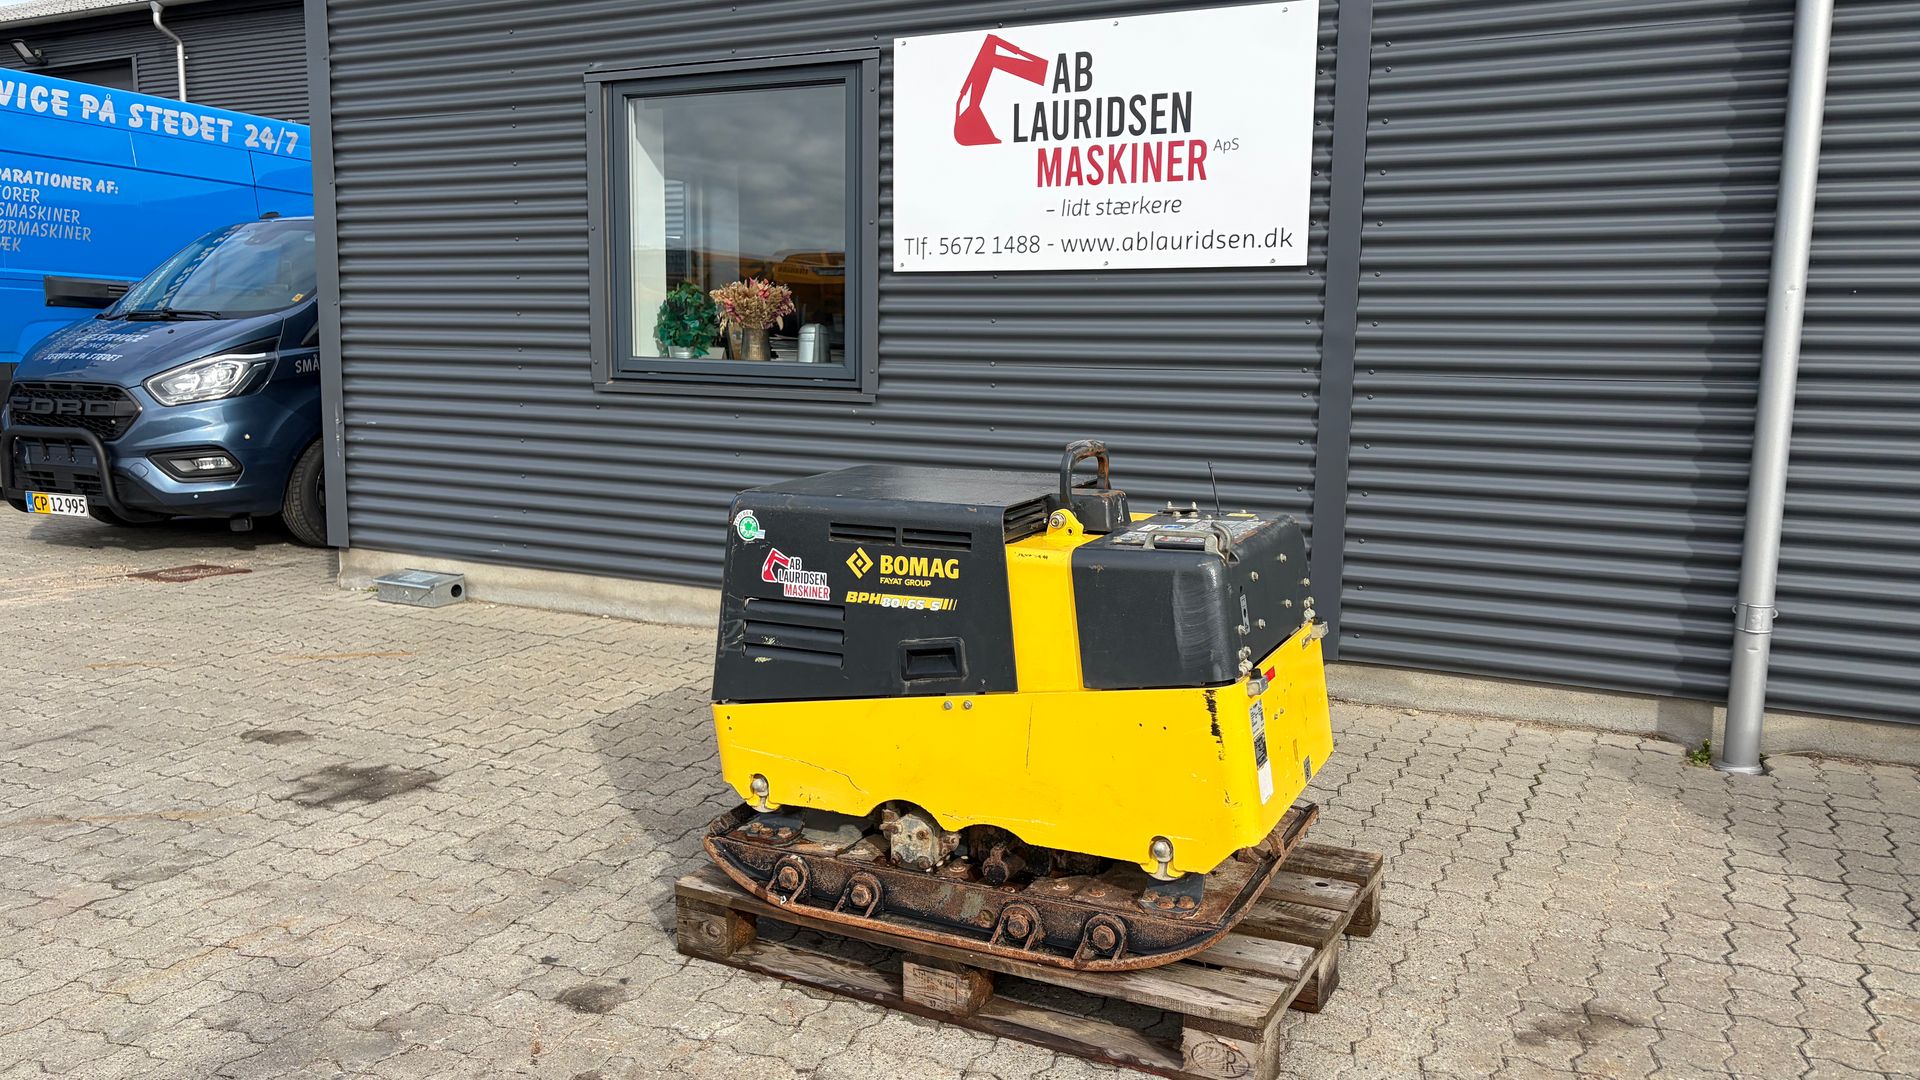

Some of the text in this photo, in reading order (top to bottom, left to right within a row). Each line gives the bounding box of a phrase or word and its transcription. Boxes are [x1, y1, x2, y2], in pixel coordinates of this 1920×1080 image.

[1052, 51, 1093, 94] AB
[80, 93, 116, 124] PÅ
[128, 103, 233, 143] STEDET
[244, 124, 299, 154] 24/7
[1013, 91, 1193, 143] LAURIDSEN
[1037, 137, 1240, 188] MASKINER ApS
[95, 179, 119, 194] AF:
[1061, 198, 1091, 217] lidt
[1096, 196, 1182, 216] stærkere
[904, 236, 933, 260] Tlf.
[939, 236, 986, 255] 5672
[992, 235, 1041, 254] 1488
[1061, 227, 1294, 253] www.ablauridsen.dk
[34, 496, 48, 511] CP
[789, 558, 801, 570] AB
[880, 555, 960, 579] BOMAG
[778, 571, 826, 586] LAURIDSEN
[880, 577, 931, 587] FAYAT GROUP
[784, 584, 829, 599] MASKINER
